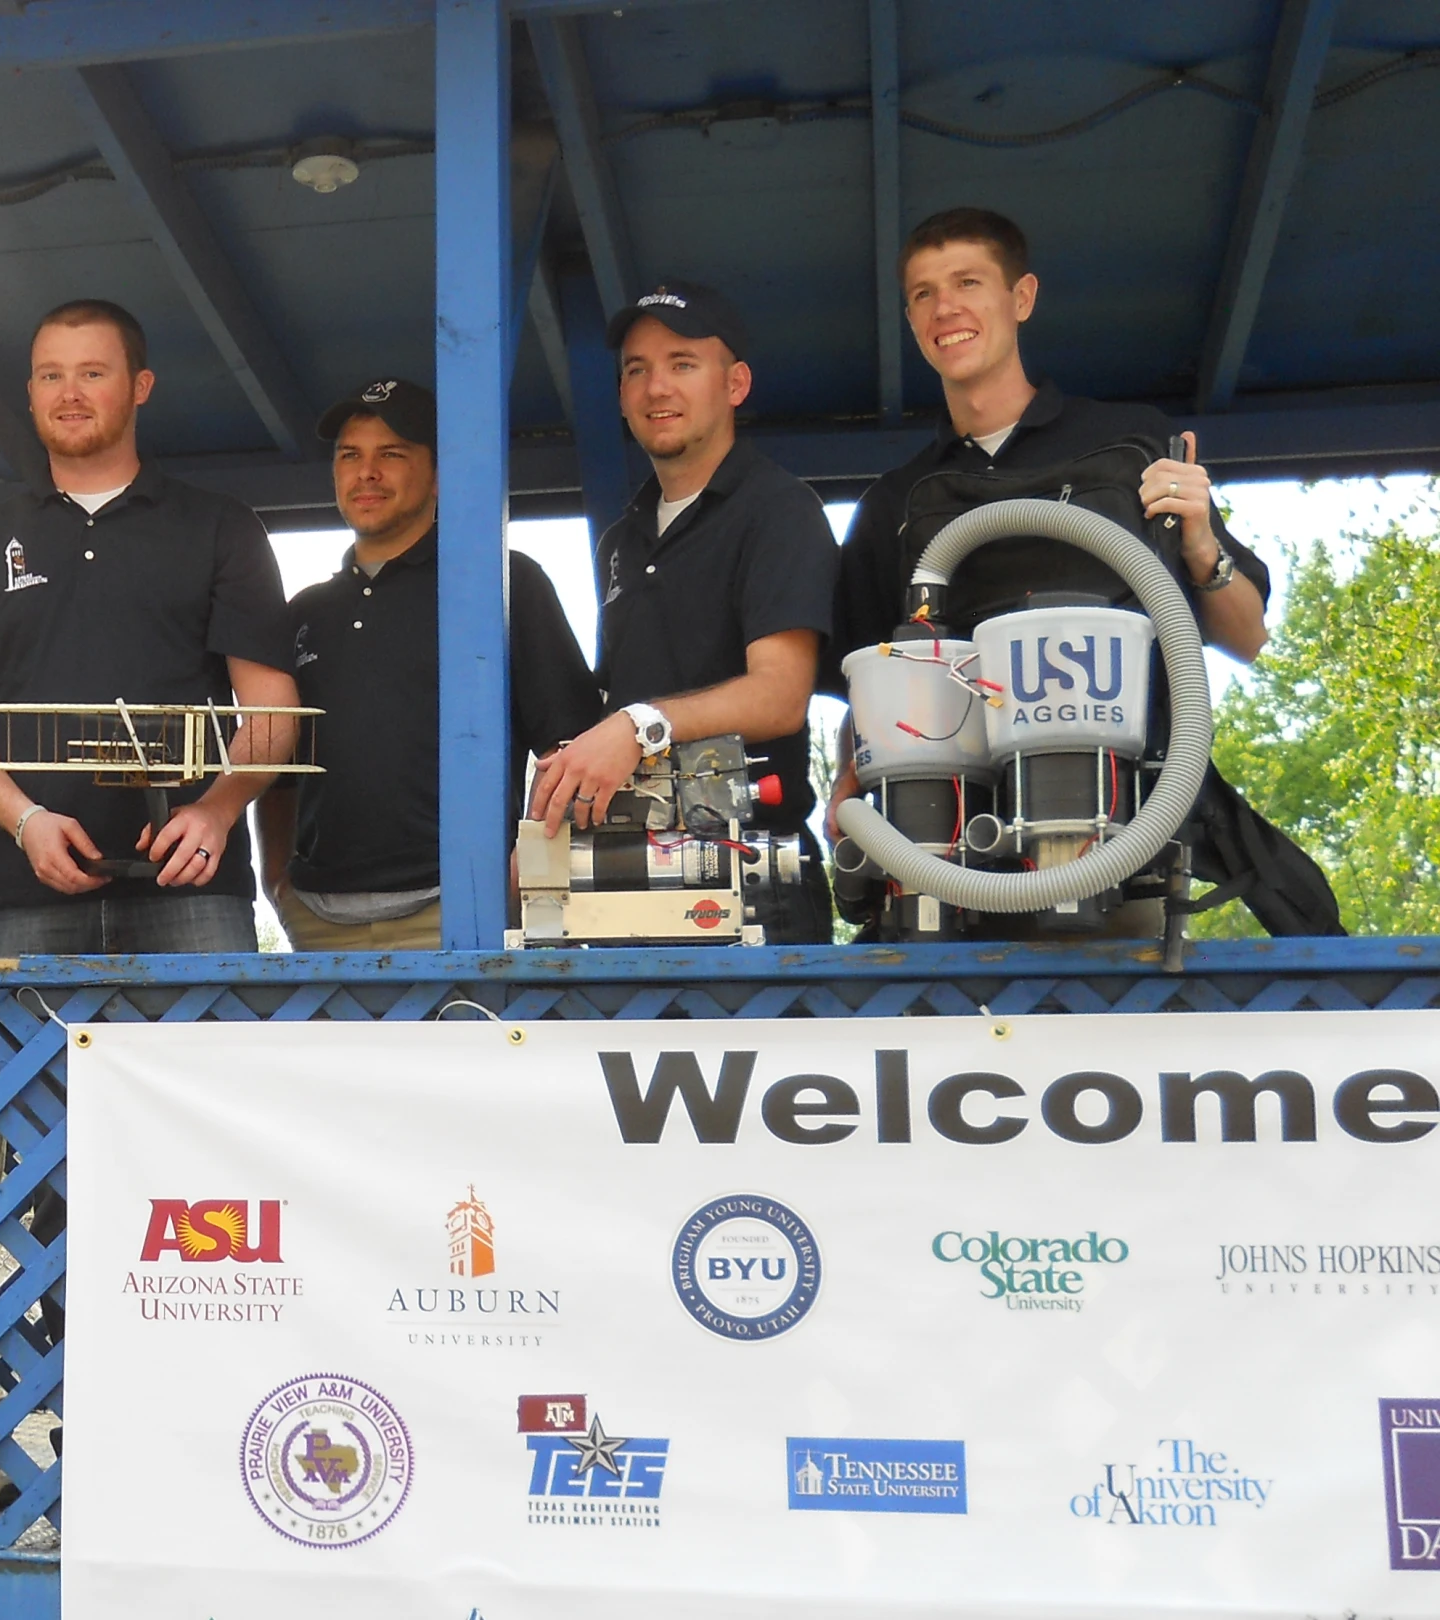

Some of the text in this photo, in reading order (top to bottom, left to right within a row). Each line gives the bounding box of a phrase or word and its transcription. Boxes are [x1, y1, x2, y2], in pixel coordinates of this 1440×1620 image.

[1010, 635, 1122, 703] USU
[1012, 704, 1124, 726] AGGIES
[596, 1046, 1440, 1146] Welcome
[139, 1198, 285, 1263] ASU
[678, 1200, 816, 1291] BRIGHAM YOUNG UNIVERSITY
[931, 1231, 1129, 1263] Colorado
[707, 1257, 787, 1281] BYU
[1215, 1244, 1440, 1280] JOHNS HOPKINS
[122, 1272, 304, 1296] ARIZONA STATE
[979, 1258, 1085, 1299] State
[1221, 1283, 1439, 1295] UNIVERSITY
[140, 1298, 284, 1322] UNIVERSITY
[387, 1288, 560, 1314] AUBURN
[1005, 1294, 1085, 1313] University
[695, 1304, 800, 1336] PROVO, UTAH
[408, 1333, 543, 1347] UNIVERSITY
[298, 1404, 356, 1421] TEACHING
[248, 1382, 405, 1485] PRAIRIE VIEW A&M UNIVERSITY
[824, 1452, 958, 1482] TENNESSEE
[1158, 1439, 1228, 1474] The
[827, 1478, 959, 1498] STATE UNIVERSITY
[1102, 1463, 1274, 1509] University
[528, 1501, 660, 1514] TEXAS ENGINEERING
[1070, 1483, 1217, 1526] of Akron
[307, 1523, 348, 1540] 1876
[528, 1515, 660, 1527] EXPERIMENT STATION
